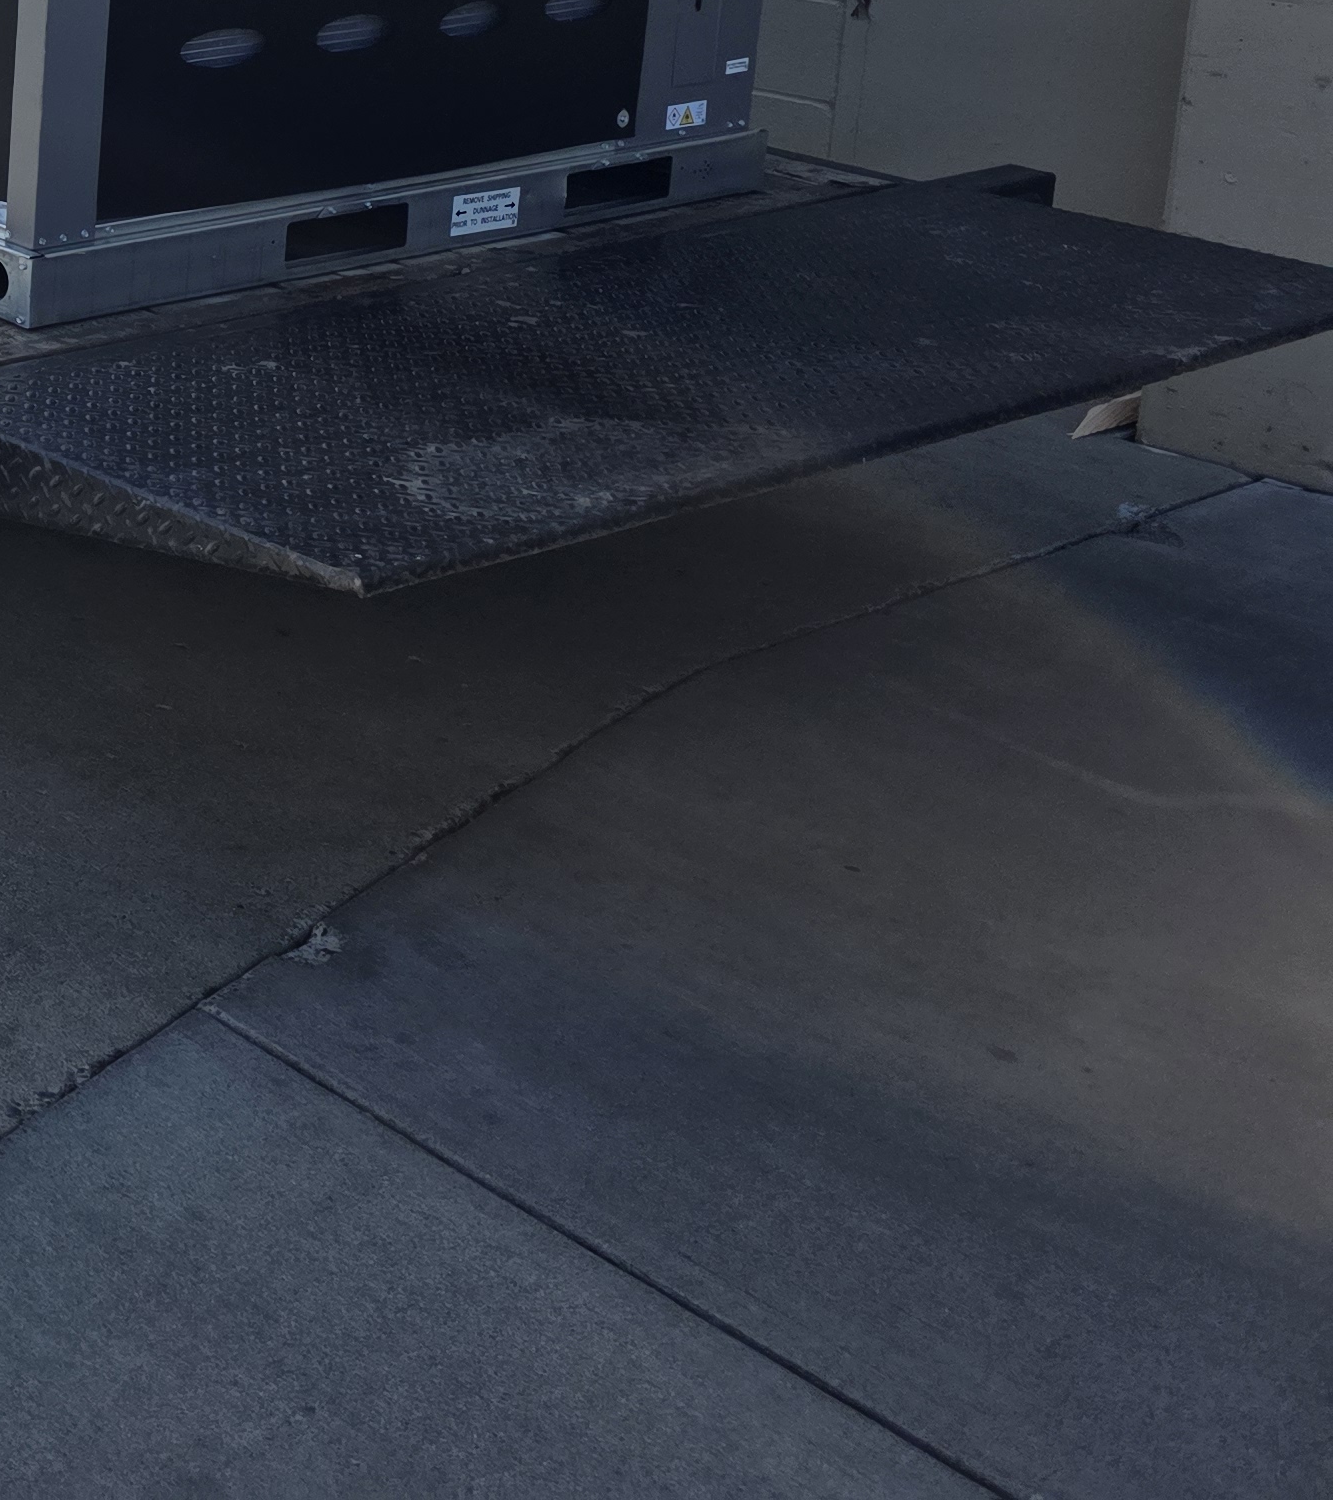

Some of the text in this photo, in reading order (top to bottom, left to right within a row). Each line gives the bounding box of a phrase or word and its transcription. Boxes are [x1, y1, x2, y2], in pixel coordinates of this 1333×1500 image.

[463, 191, 511, 205] REMOVE SHIPPING
[473, 204, 498, 215] DUNNAGE
[451, 212, 517, 228] PRIOR TO INSTALLATION
